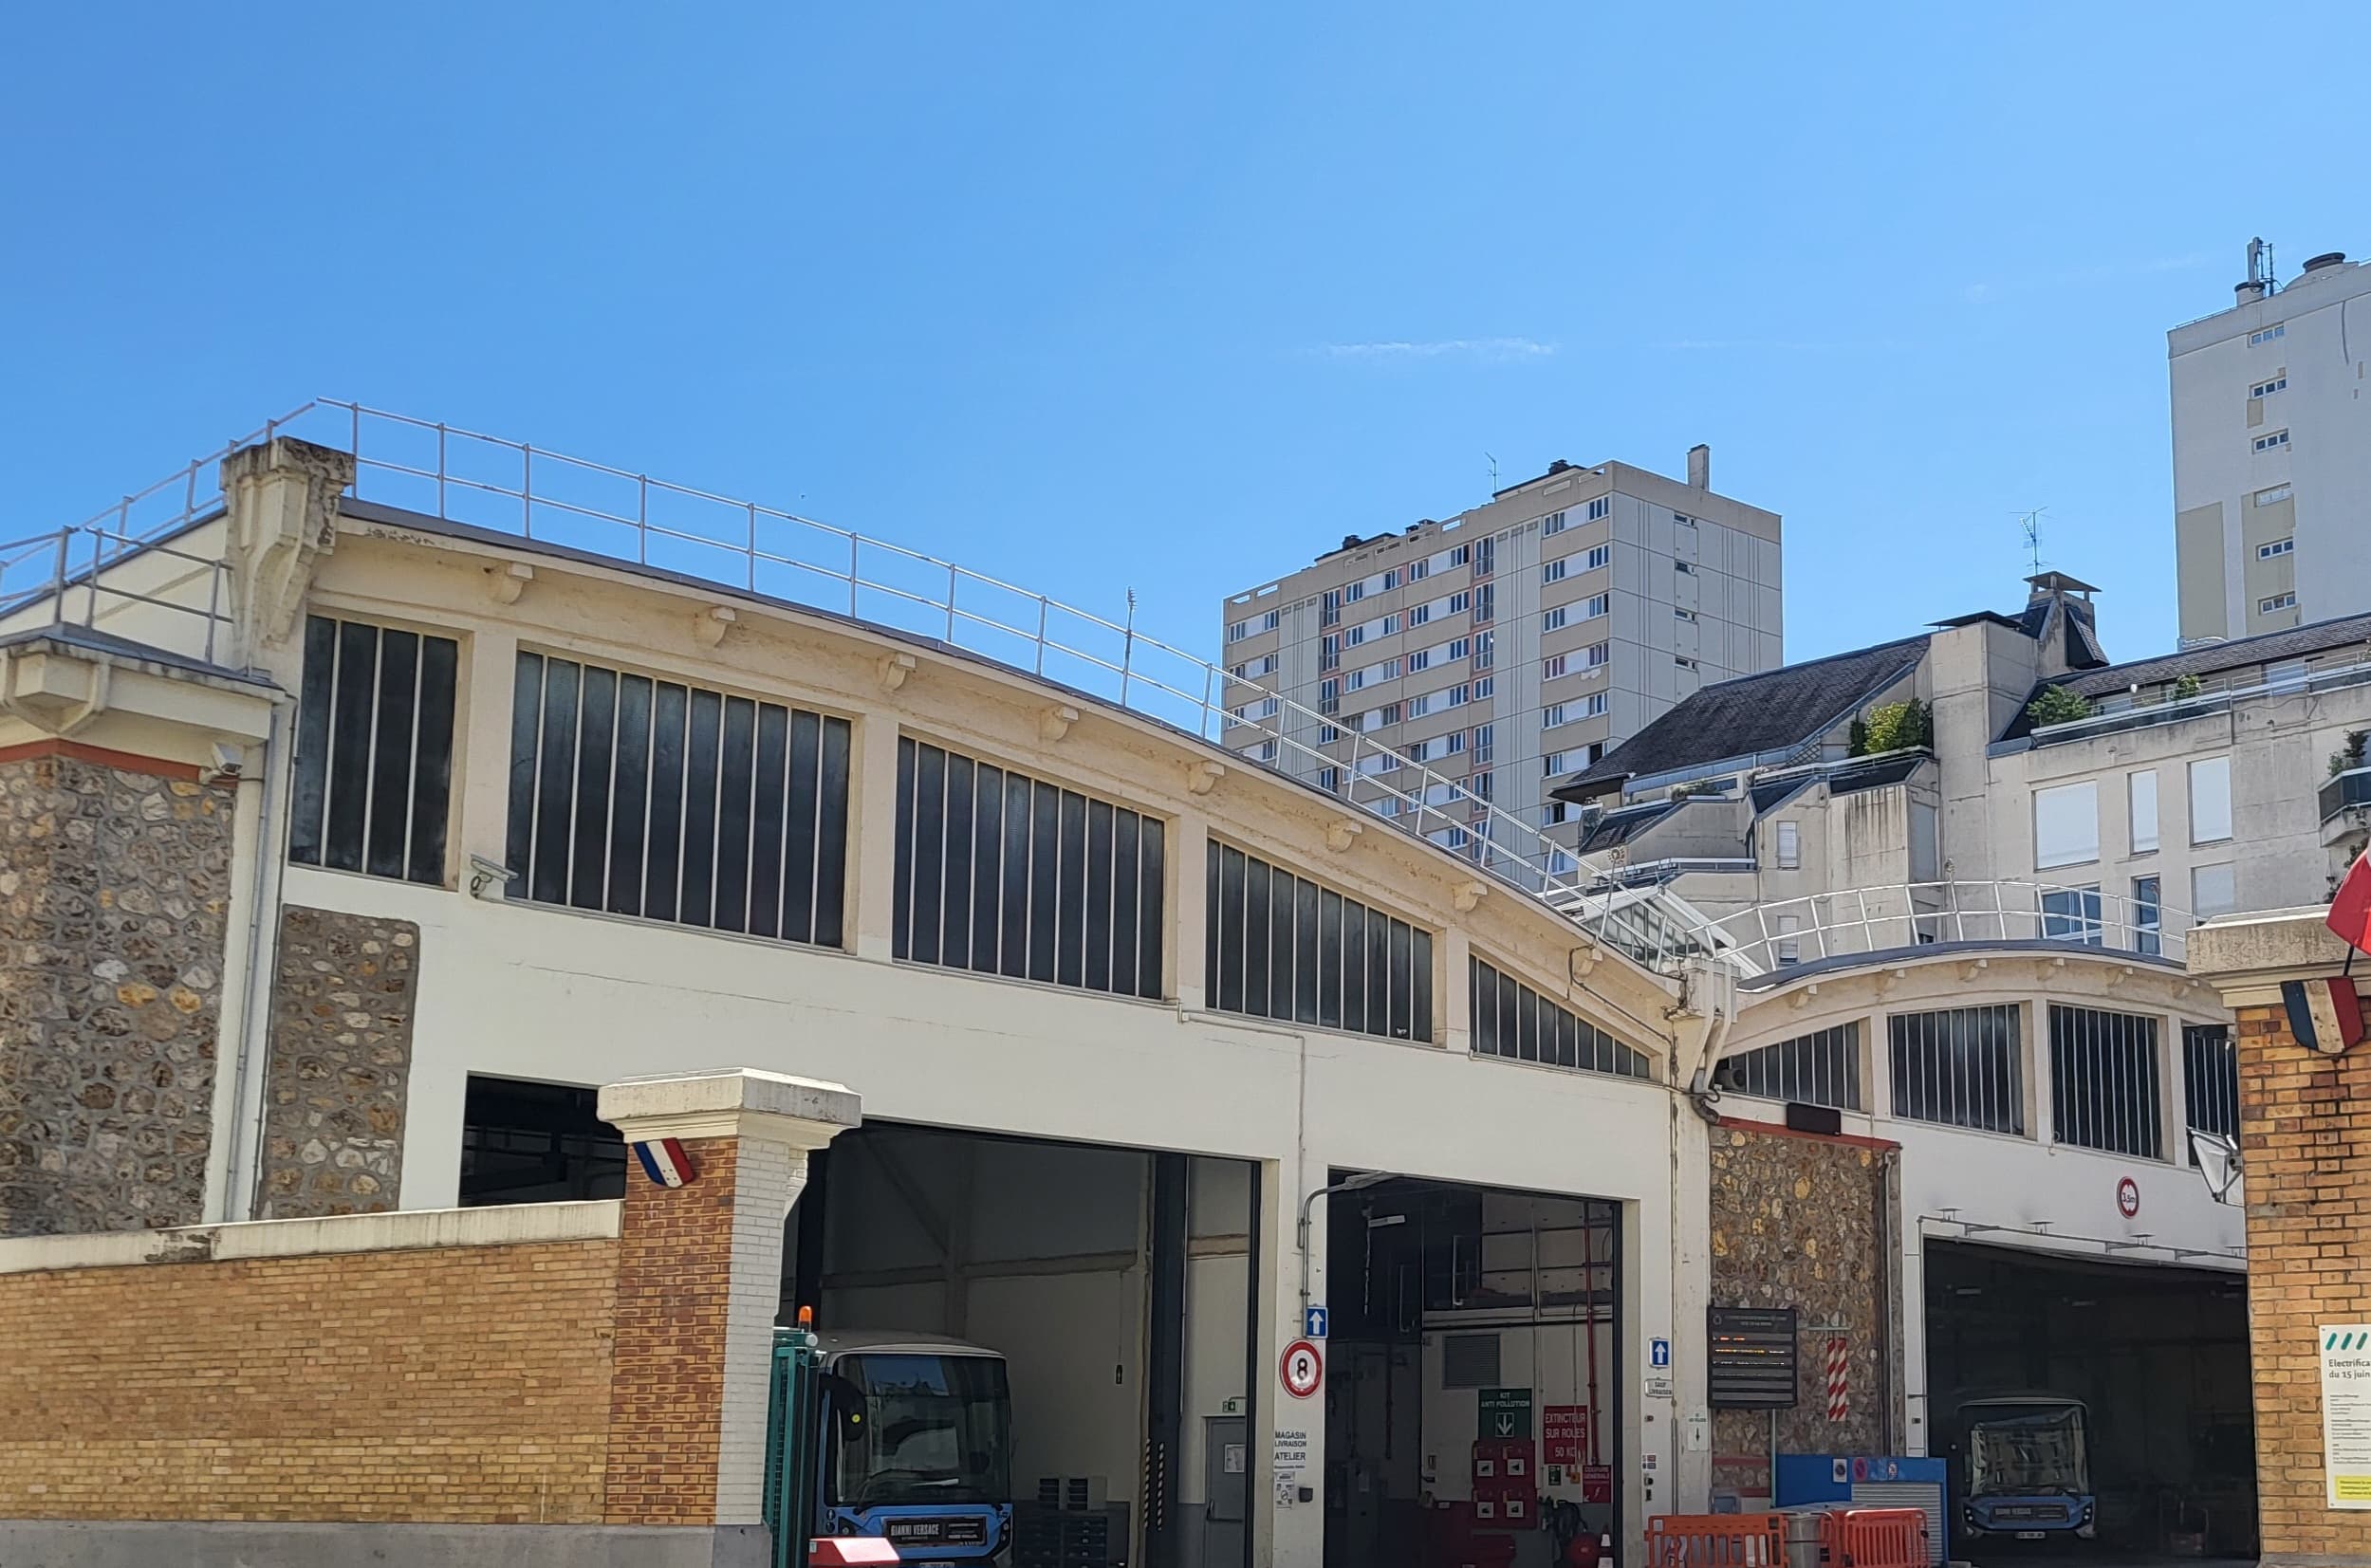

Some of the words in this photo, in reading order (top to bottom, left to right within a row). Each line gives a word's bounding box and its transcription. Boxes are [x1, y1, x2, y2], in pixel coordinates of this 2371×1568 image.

[1297, 1357, 1308, 1380] 8
[2328, 1370, 2340, 1378] du
[2342, 1371, 2352, 1379] 15
[2354, 1370, 2370, 1380] juin
[1545, 1412, 1586, 1424] EXTINCTEUR
[1274, 1430, 1306, 1440] MAGASIN
[1546, 1428, 1560, 1439] SUR
[1561, 1428, 1585, 1439] ROUES
[1274, 1451, 1306, 1461] ATELIER
[1555, 1447, 1565, 1457] 50
[891, 1524, 912, 1536] GIANNI
[913, 1523, 939, 1535] VERSACE
